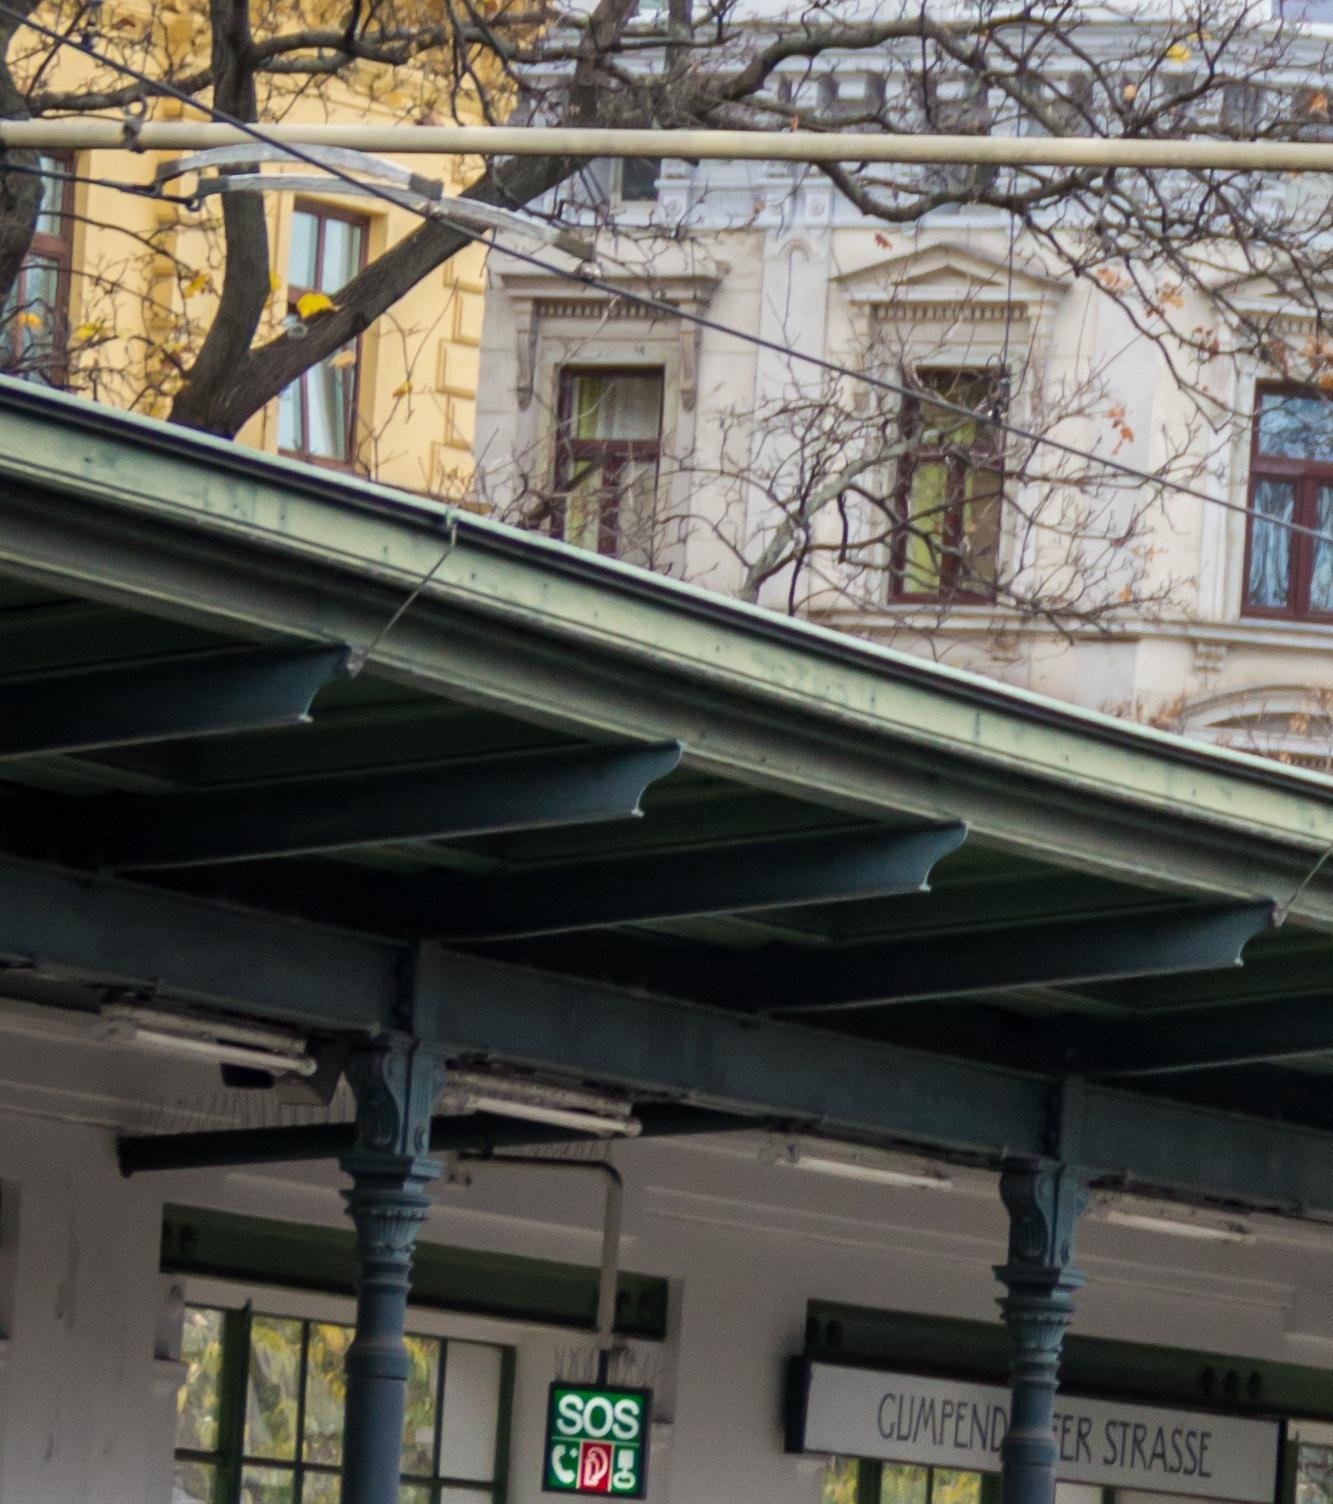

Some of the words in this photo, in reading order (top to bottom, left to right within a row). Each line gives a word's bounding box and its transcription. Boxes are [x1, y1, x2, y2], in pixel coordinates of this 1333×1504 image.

[556, 1393, 640, 1440] SOS
[877, 1392, 1093, 1465] GUMPENDER
[1102, 1418, 1213, 1479] STRASSE
